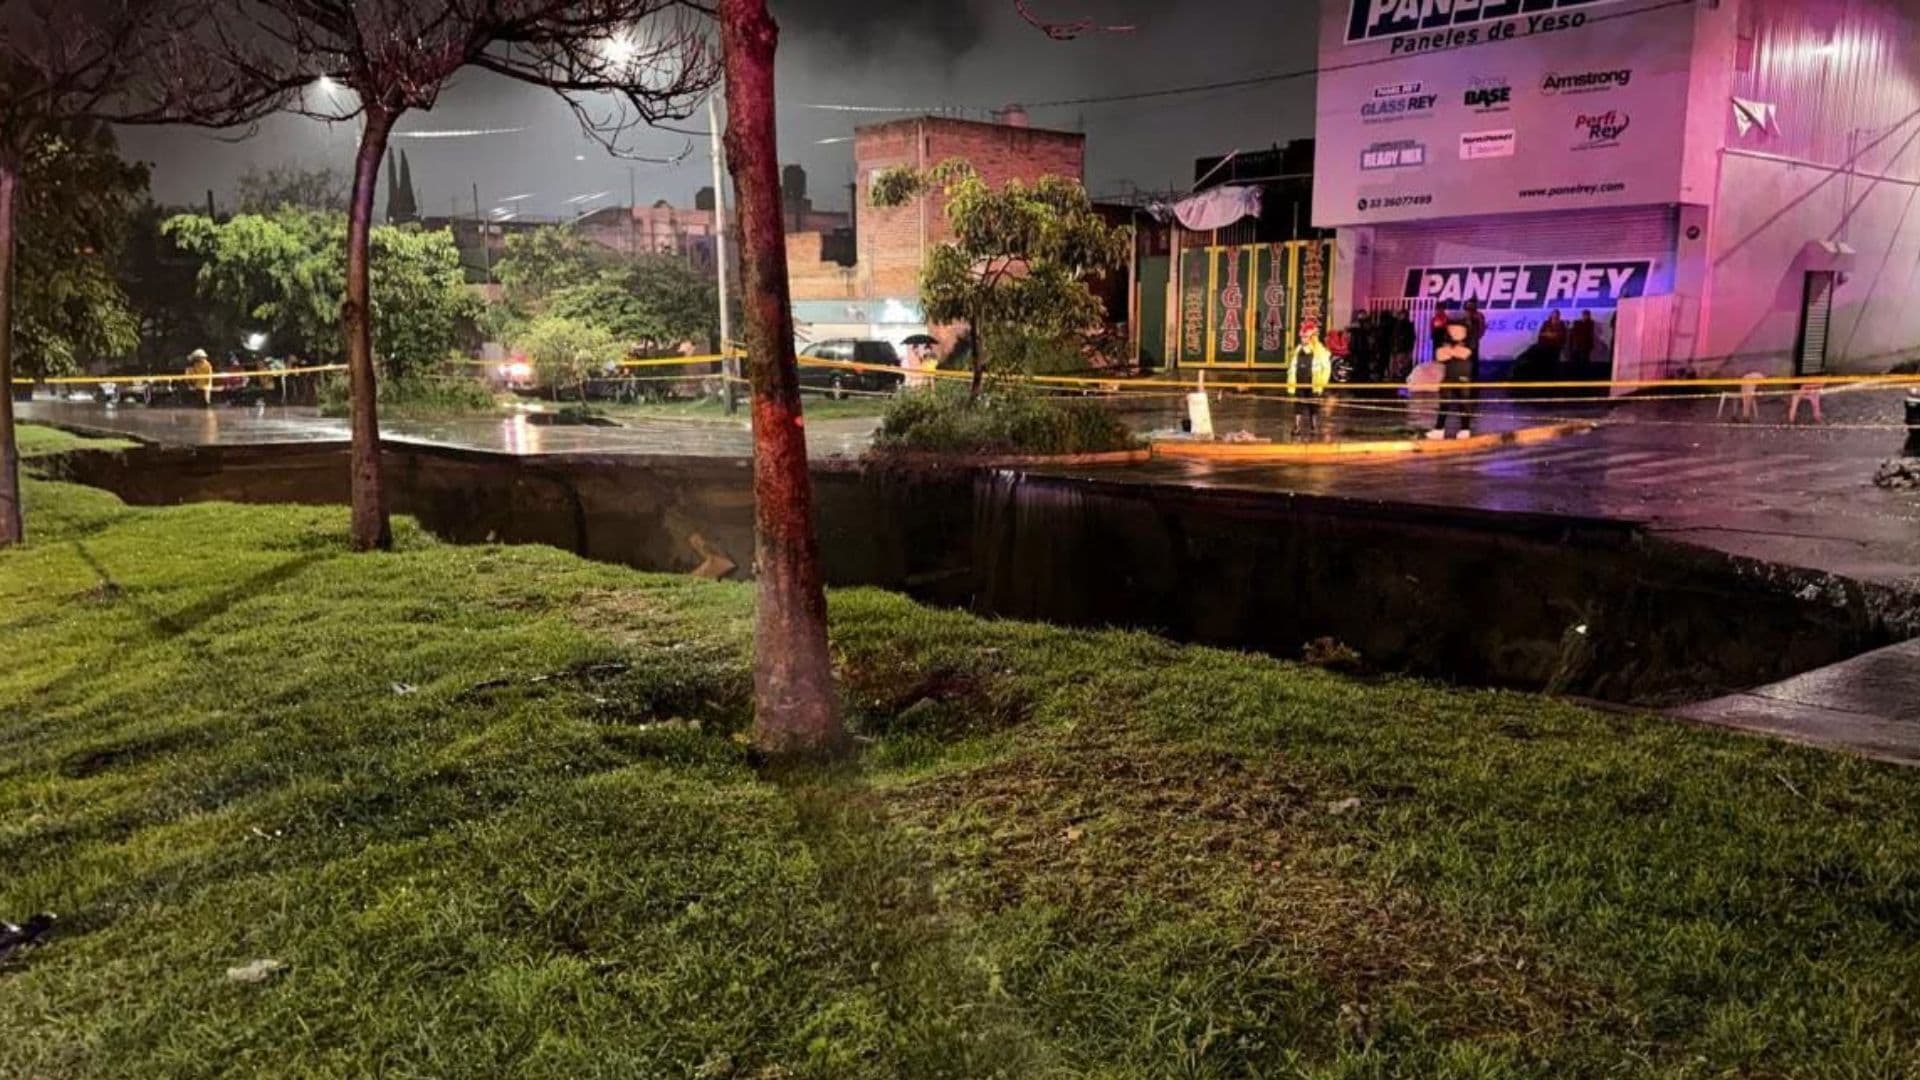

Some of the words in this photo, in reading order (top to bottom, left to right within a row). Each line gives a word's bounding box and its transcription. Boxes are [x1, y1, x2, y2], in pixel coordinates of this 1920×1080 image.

[1391, 27, 1478, 54] Paneles
[1488, 20, 1516, 41] de
[1527, 11, 1586, 35] Yeso
[1543, 69, 1632, 89] Armstrong
[1361, 99, 1406, 117] GLASS
[1407, 94, 1437, 111] REY
[1574, 110, 1617, 129] Perfi
[1589, 123, 1629, 140] Rey
[1262, 241, 1285, 351] VIGAS
[1419, 269, 1538, 299] PANEL
[1547, 267, 1634, 298] REY
[1221, 245, 1242, 353] VIGAS
